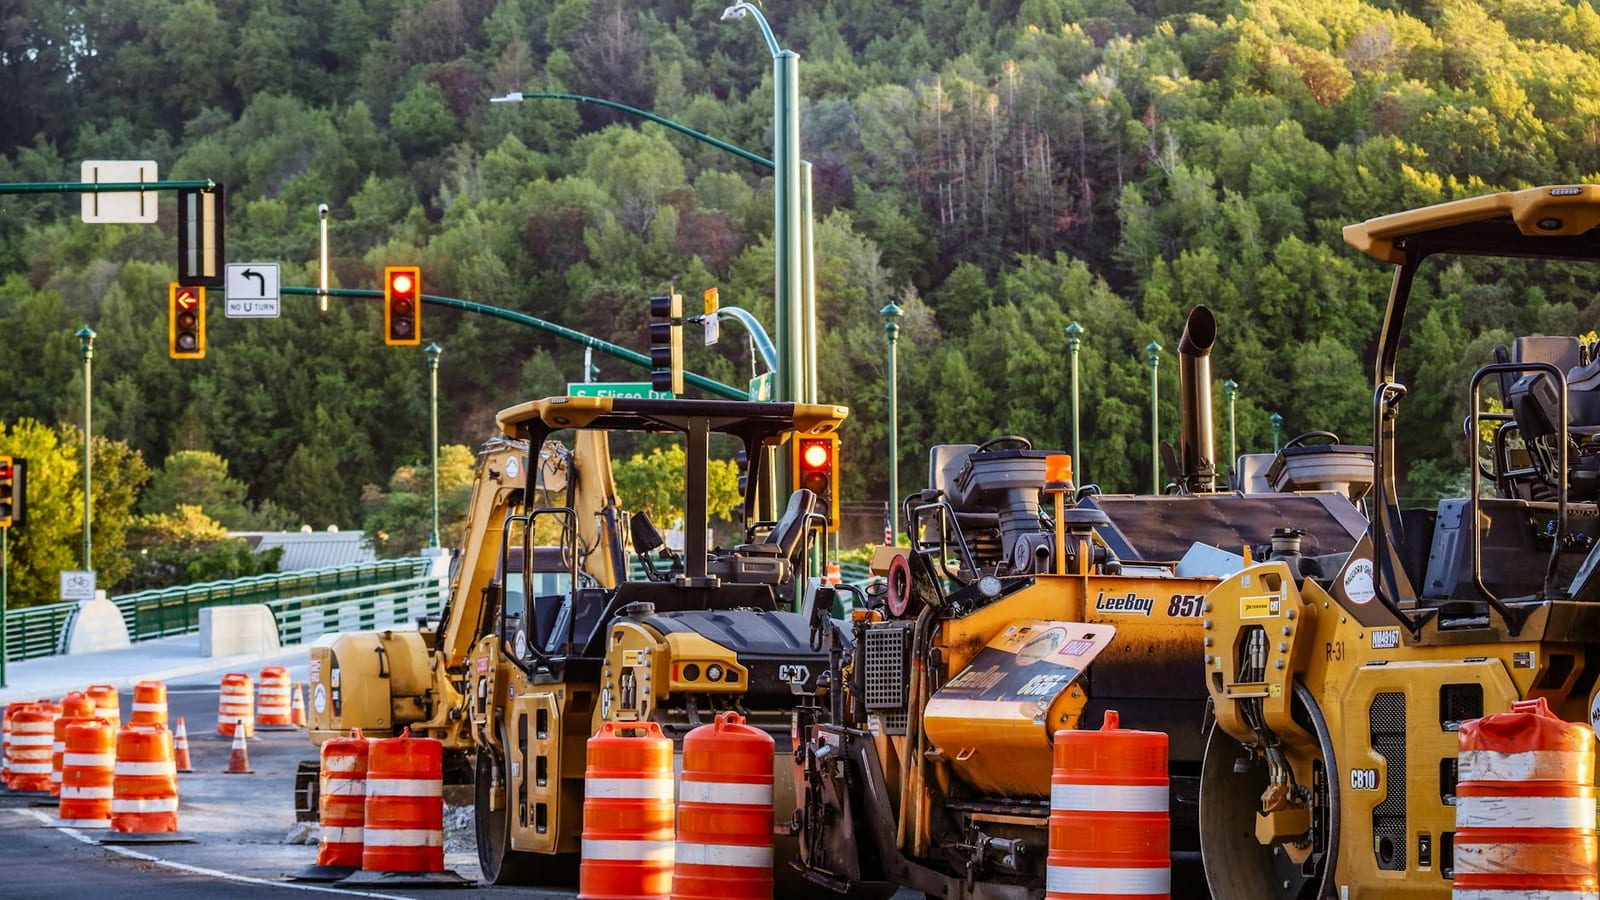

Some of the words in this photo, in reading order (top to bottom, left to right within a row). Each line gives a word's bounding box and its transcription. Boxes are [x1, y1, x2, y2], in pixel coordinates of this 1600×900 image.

[243, 302, 252, 312] U
[1096, 592, 1154, 617] LeeBoy
[1167, 594, 1203, 617] 851
[1326, 642, 1345, 661] R-31
[1351, 769, 1375, 789] CB10
